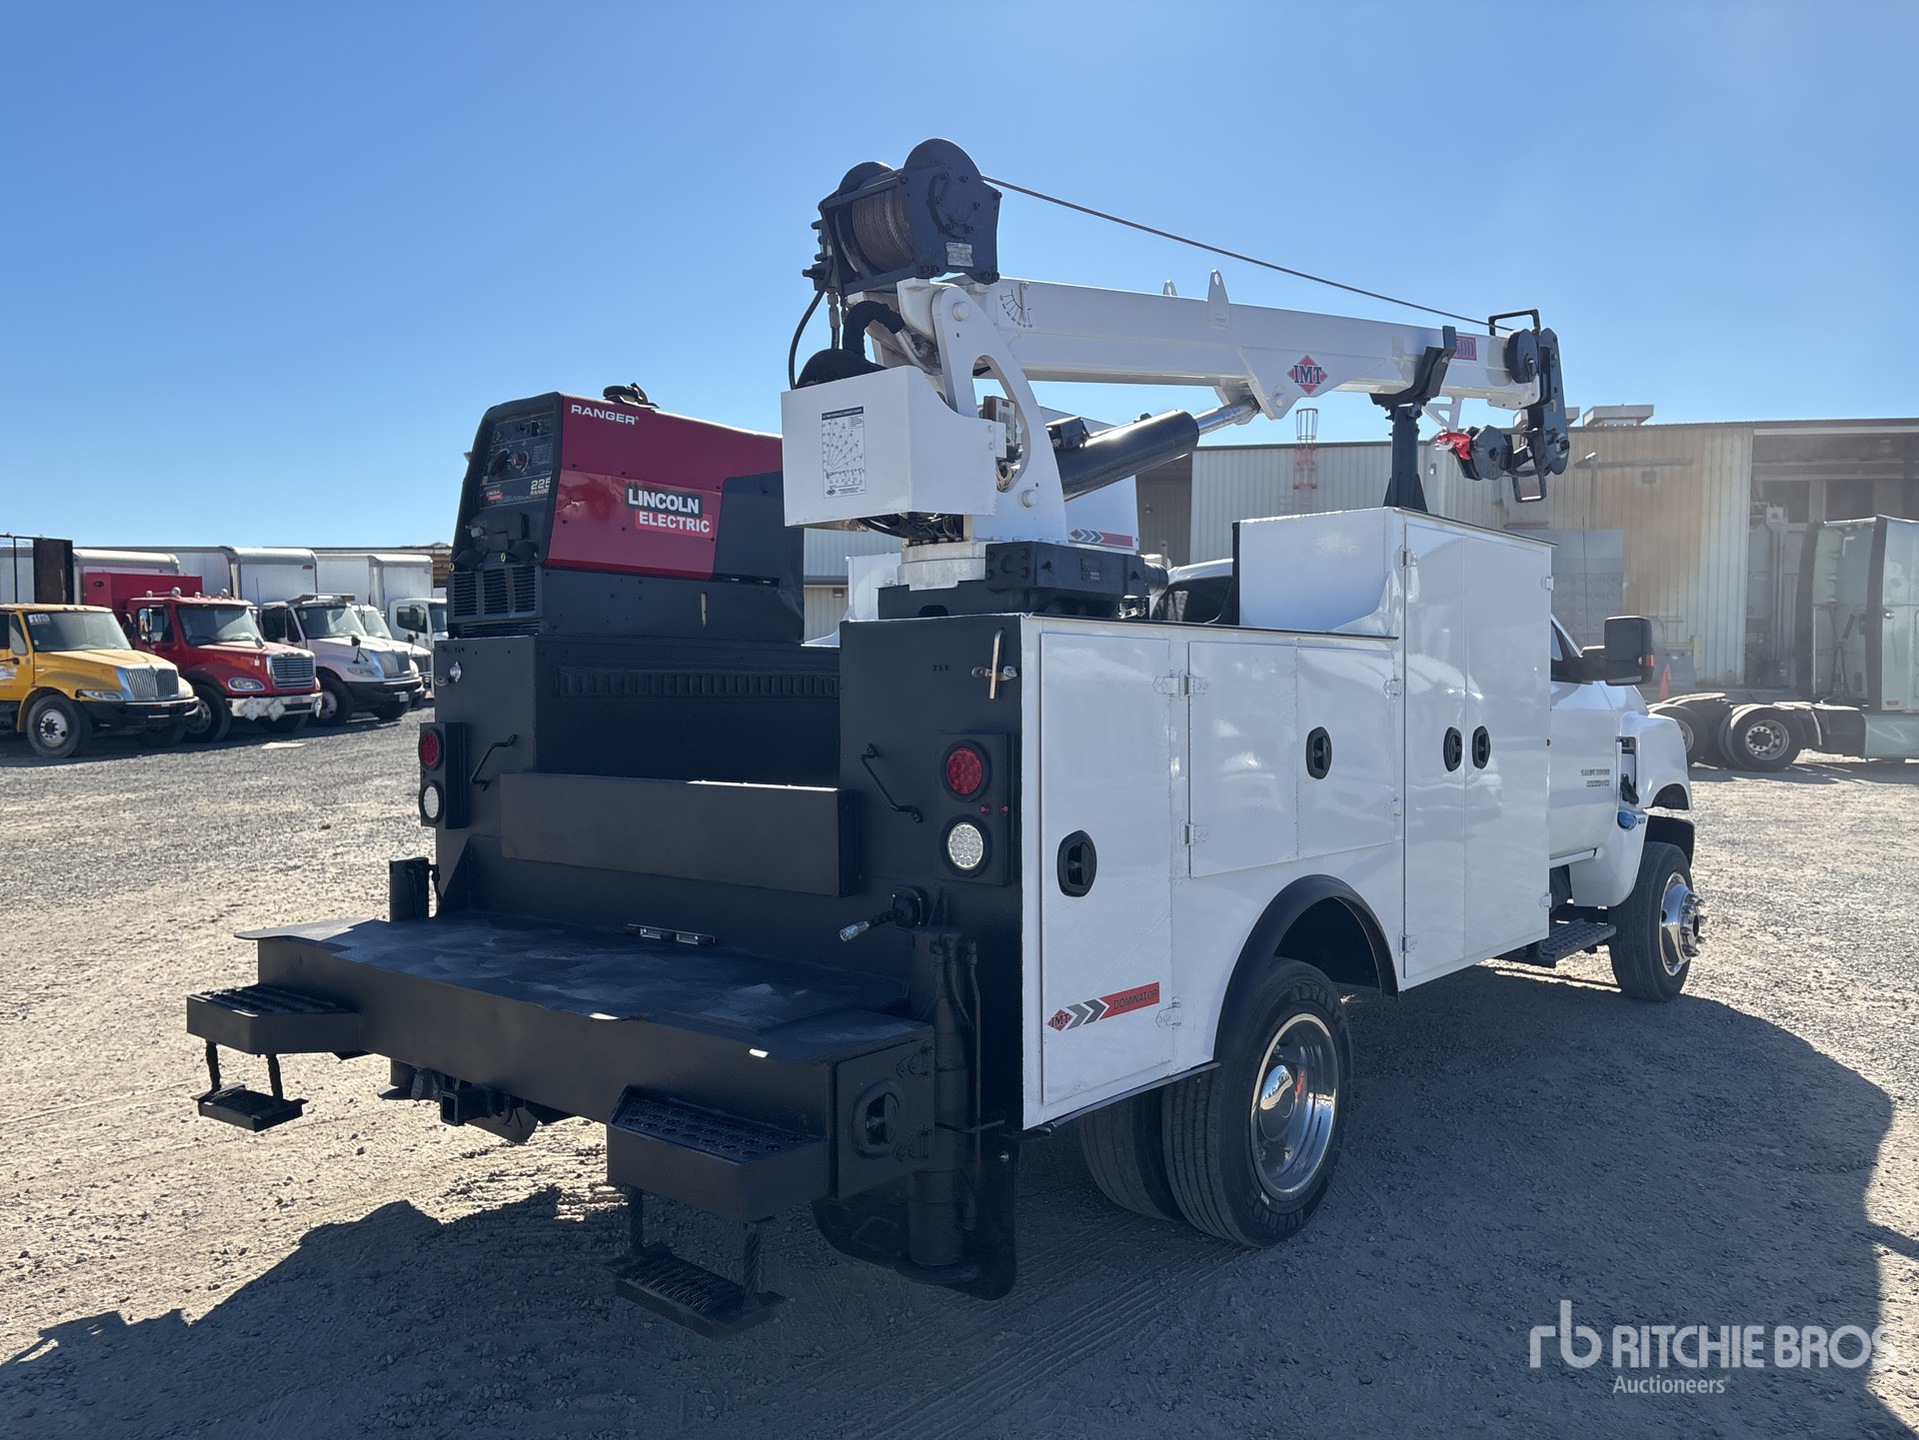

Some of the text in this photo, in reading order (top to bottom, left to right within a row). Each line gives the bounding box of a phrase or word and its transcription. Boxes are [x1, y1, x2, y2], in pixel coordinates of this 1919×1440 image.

[1293, 365, 1322, 385] IMT
[628, 488, 699, 514] LINCOLN
[639, 511, 710, 533] ELECTRIC
[1051, 988, 1159, 1028] IMT DOMINATOR
